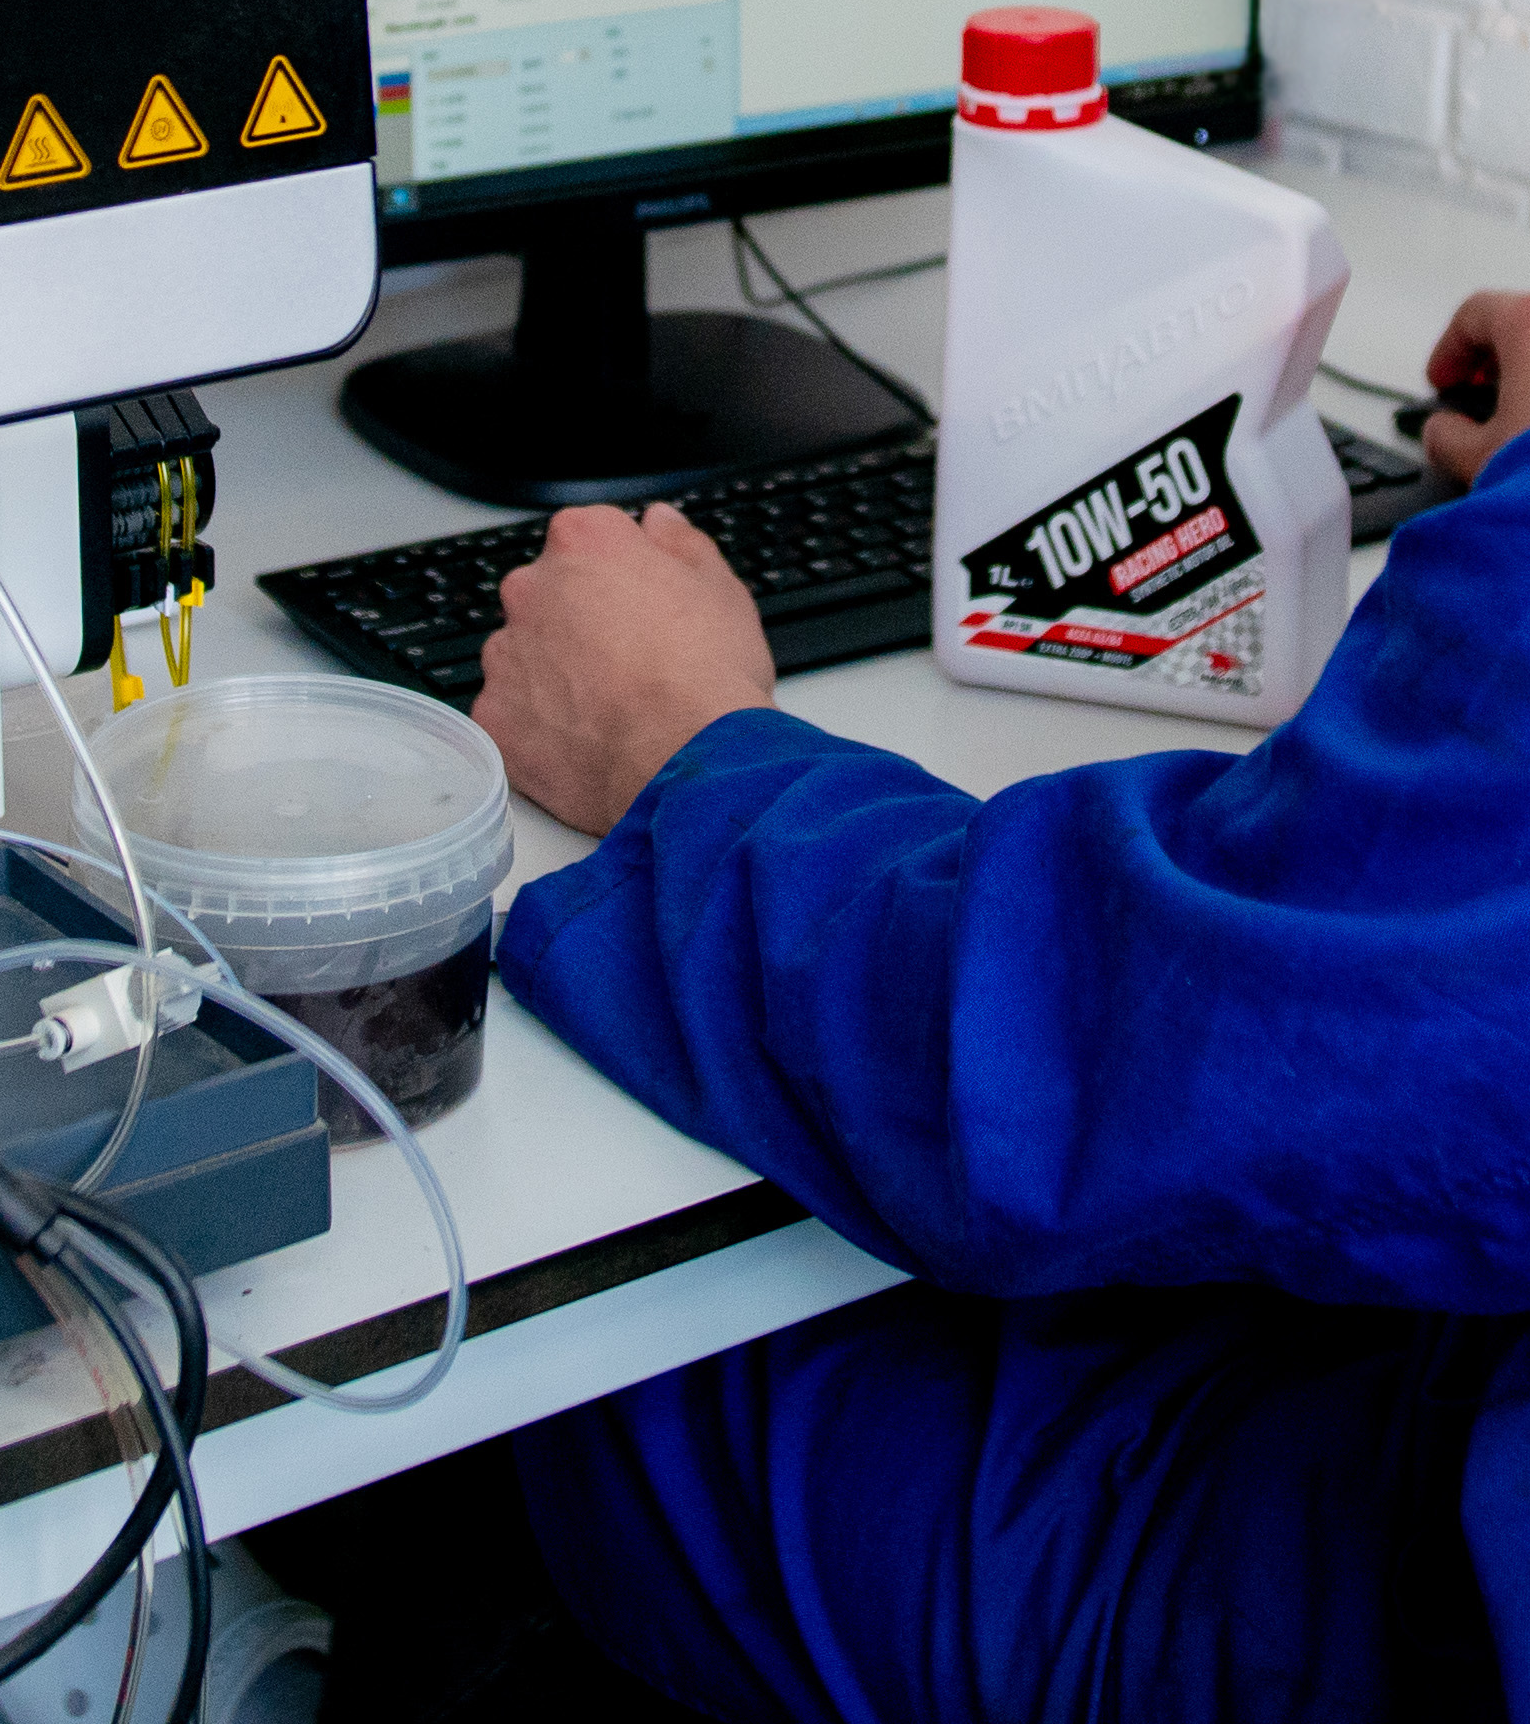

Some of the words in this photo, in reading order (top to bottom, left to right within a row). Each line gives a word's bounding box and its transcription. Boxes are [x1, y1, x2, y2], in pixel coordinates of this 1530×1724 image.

[1025, 436, 1211, 590] 10W-50
[1113, 534, 1180, 589] RACING
[1174, 506, 1227, 552] HERO
